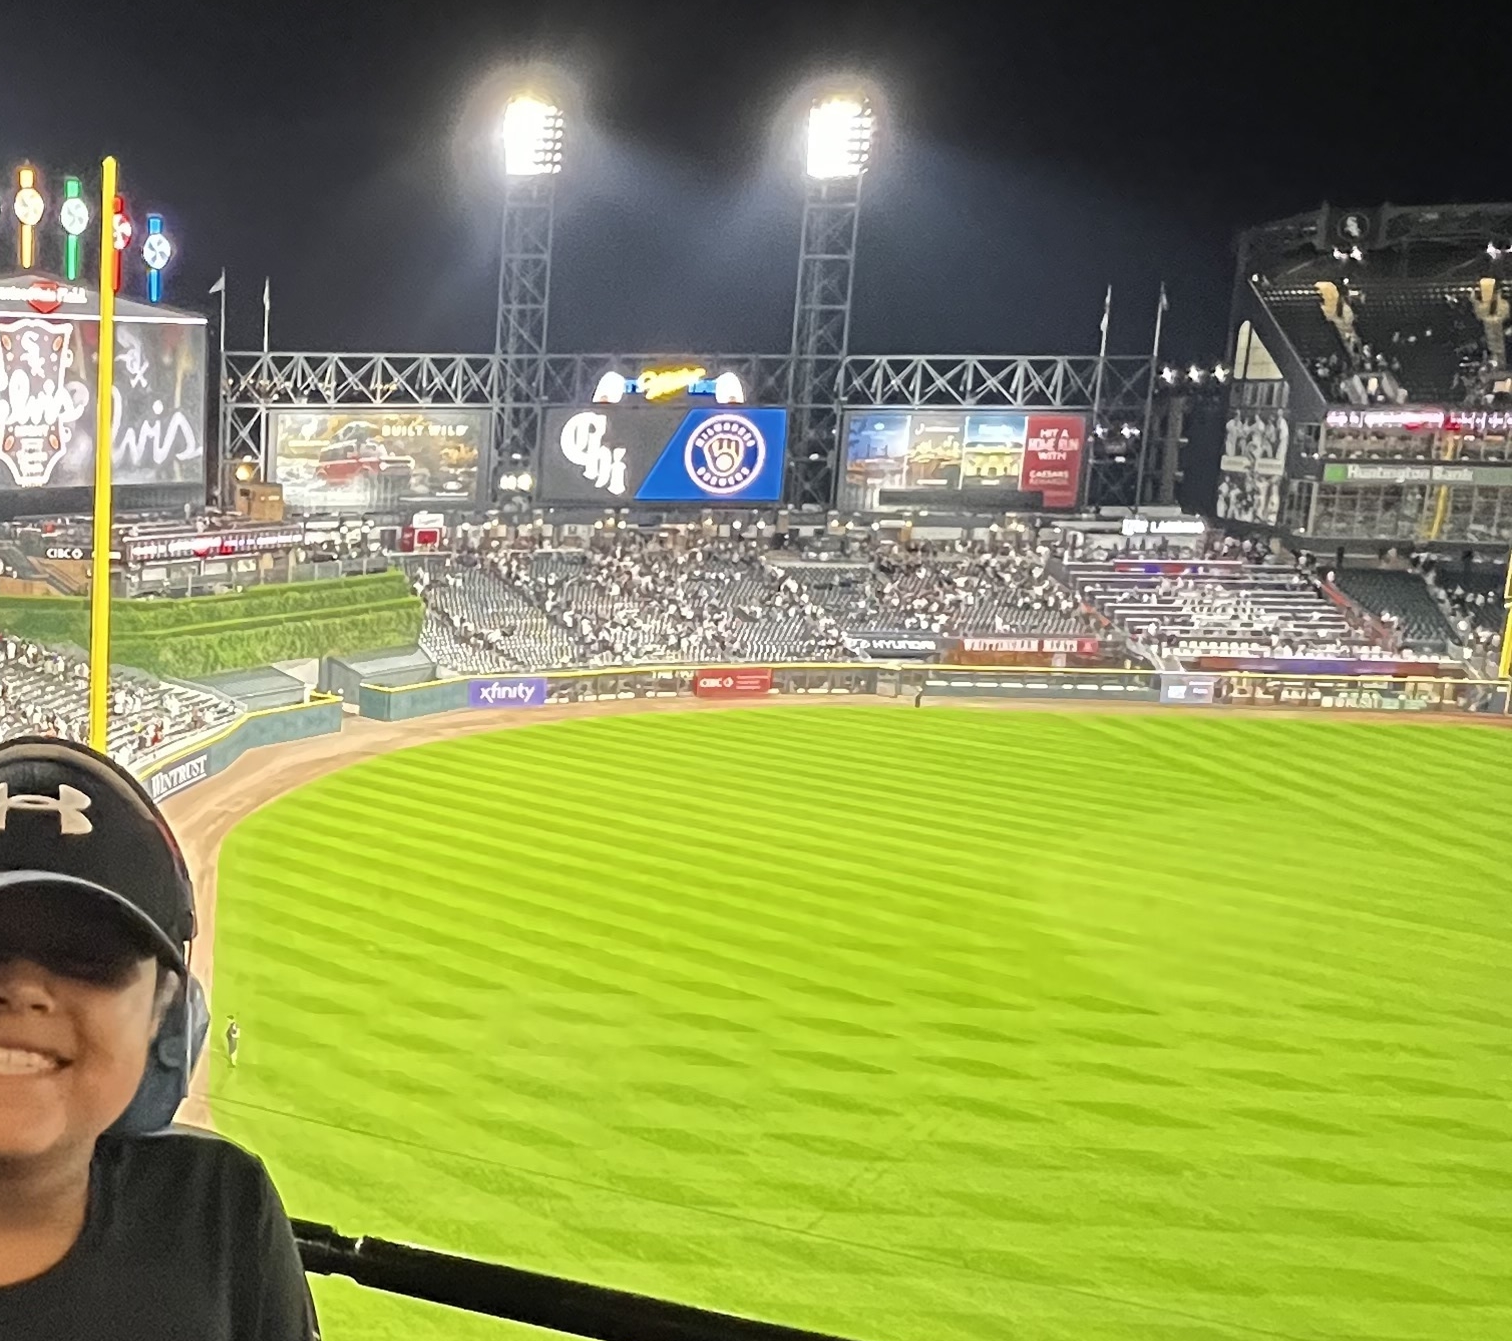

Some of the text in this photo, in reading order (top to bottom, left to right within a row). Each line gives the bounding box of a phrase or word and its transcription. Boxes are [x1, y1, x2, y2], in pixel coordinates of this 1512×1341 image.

[1348, 465, 1473, 483] Huntington Bank
[872, 639, 937, 651] HYUNDAI
[479, 681, 536, 704] xfinity
[151, 753, 208, 798] WINTRUST
